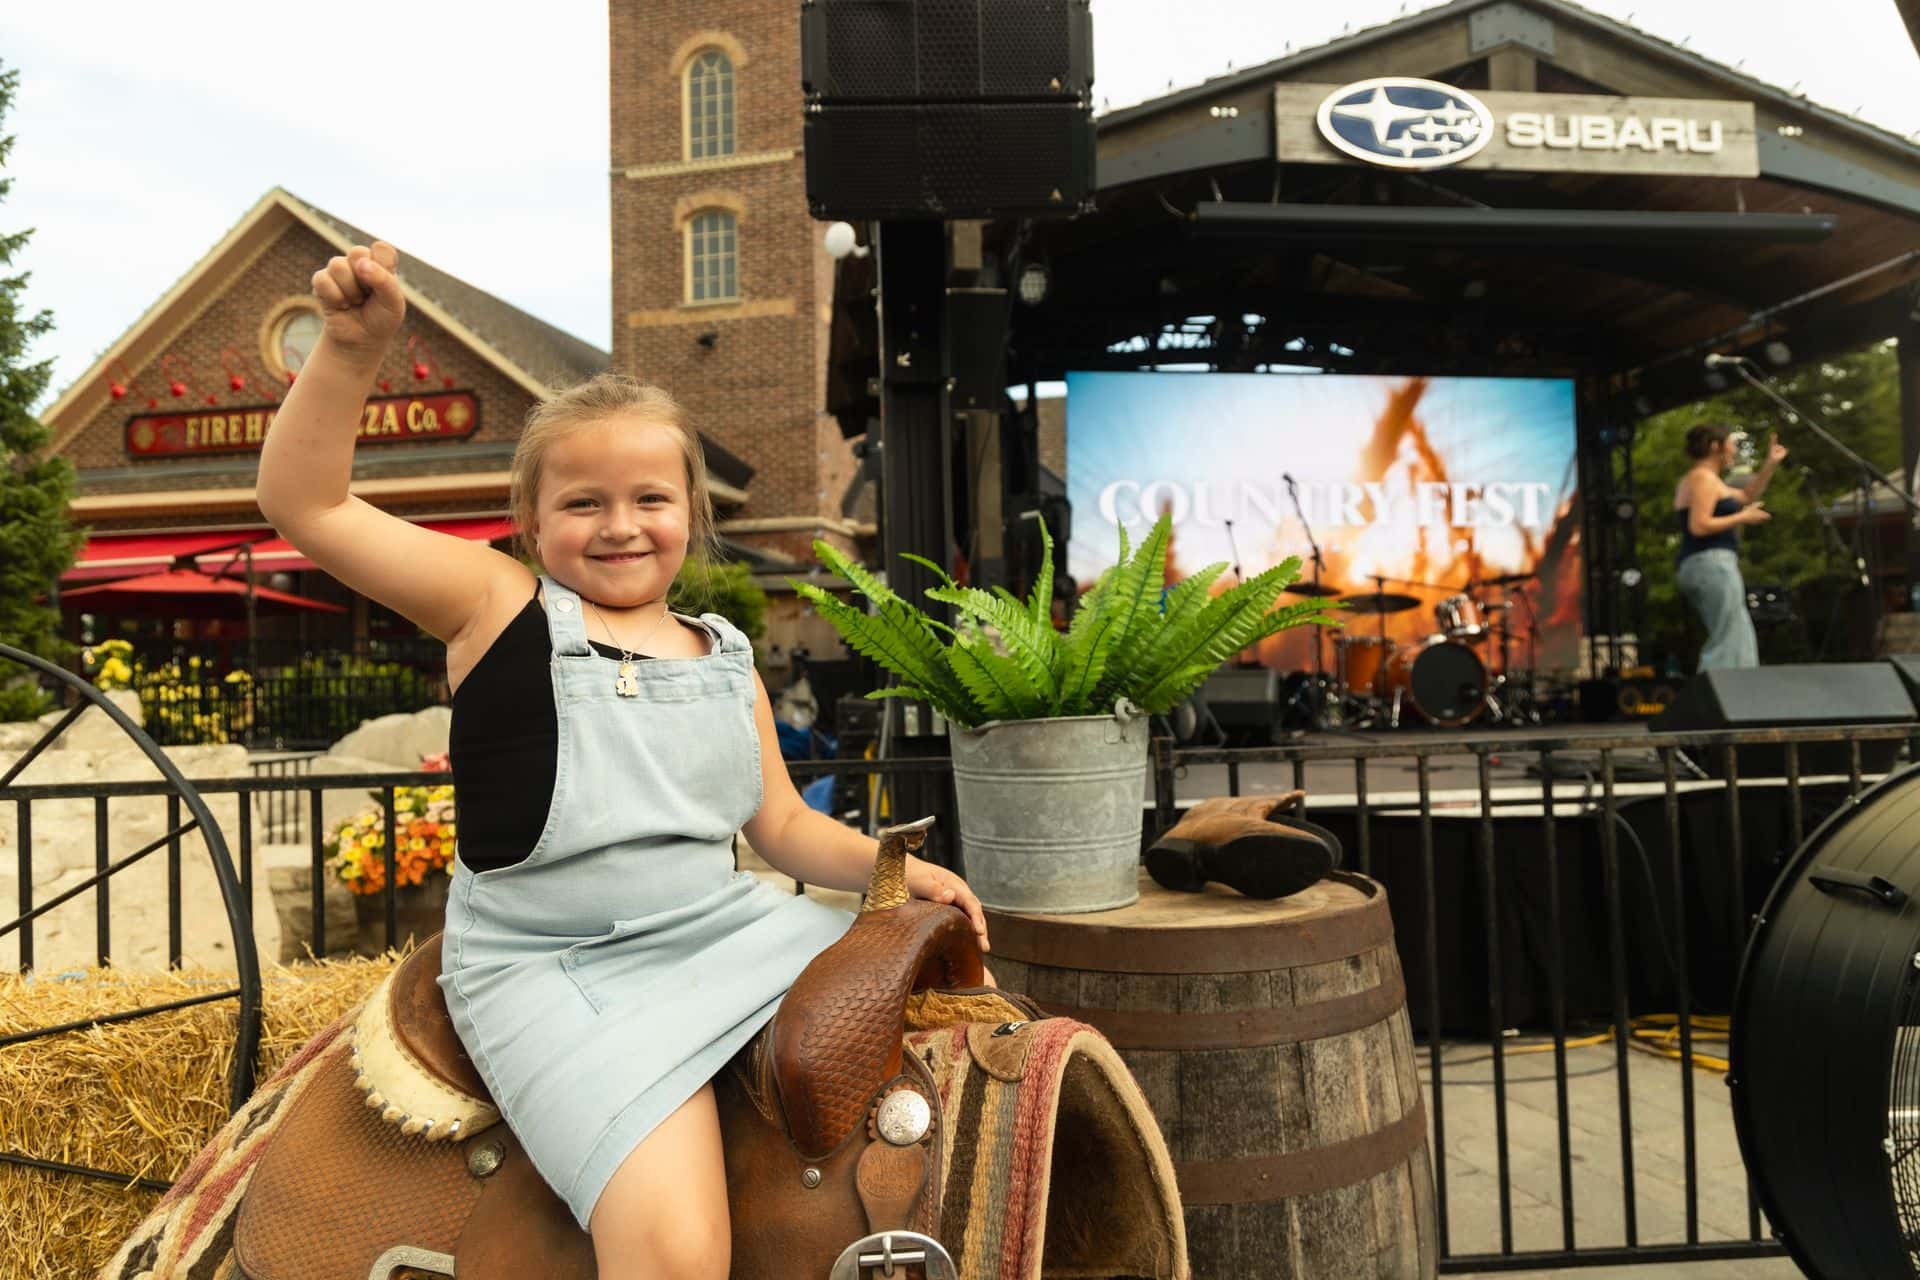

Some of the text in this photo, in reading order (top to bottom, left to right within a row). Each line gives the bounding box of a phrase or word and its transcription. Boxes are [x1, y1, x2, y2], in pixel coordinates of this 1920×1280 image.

[1506, 112, 1723, 153] SUBARU
[1099, 480, 1550, 527] COUNTRY FEST
